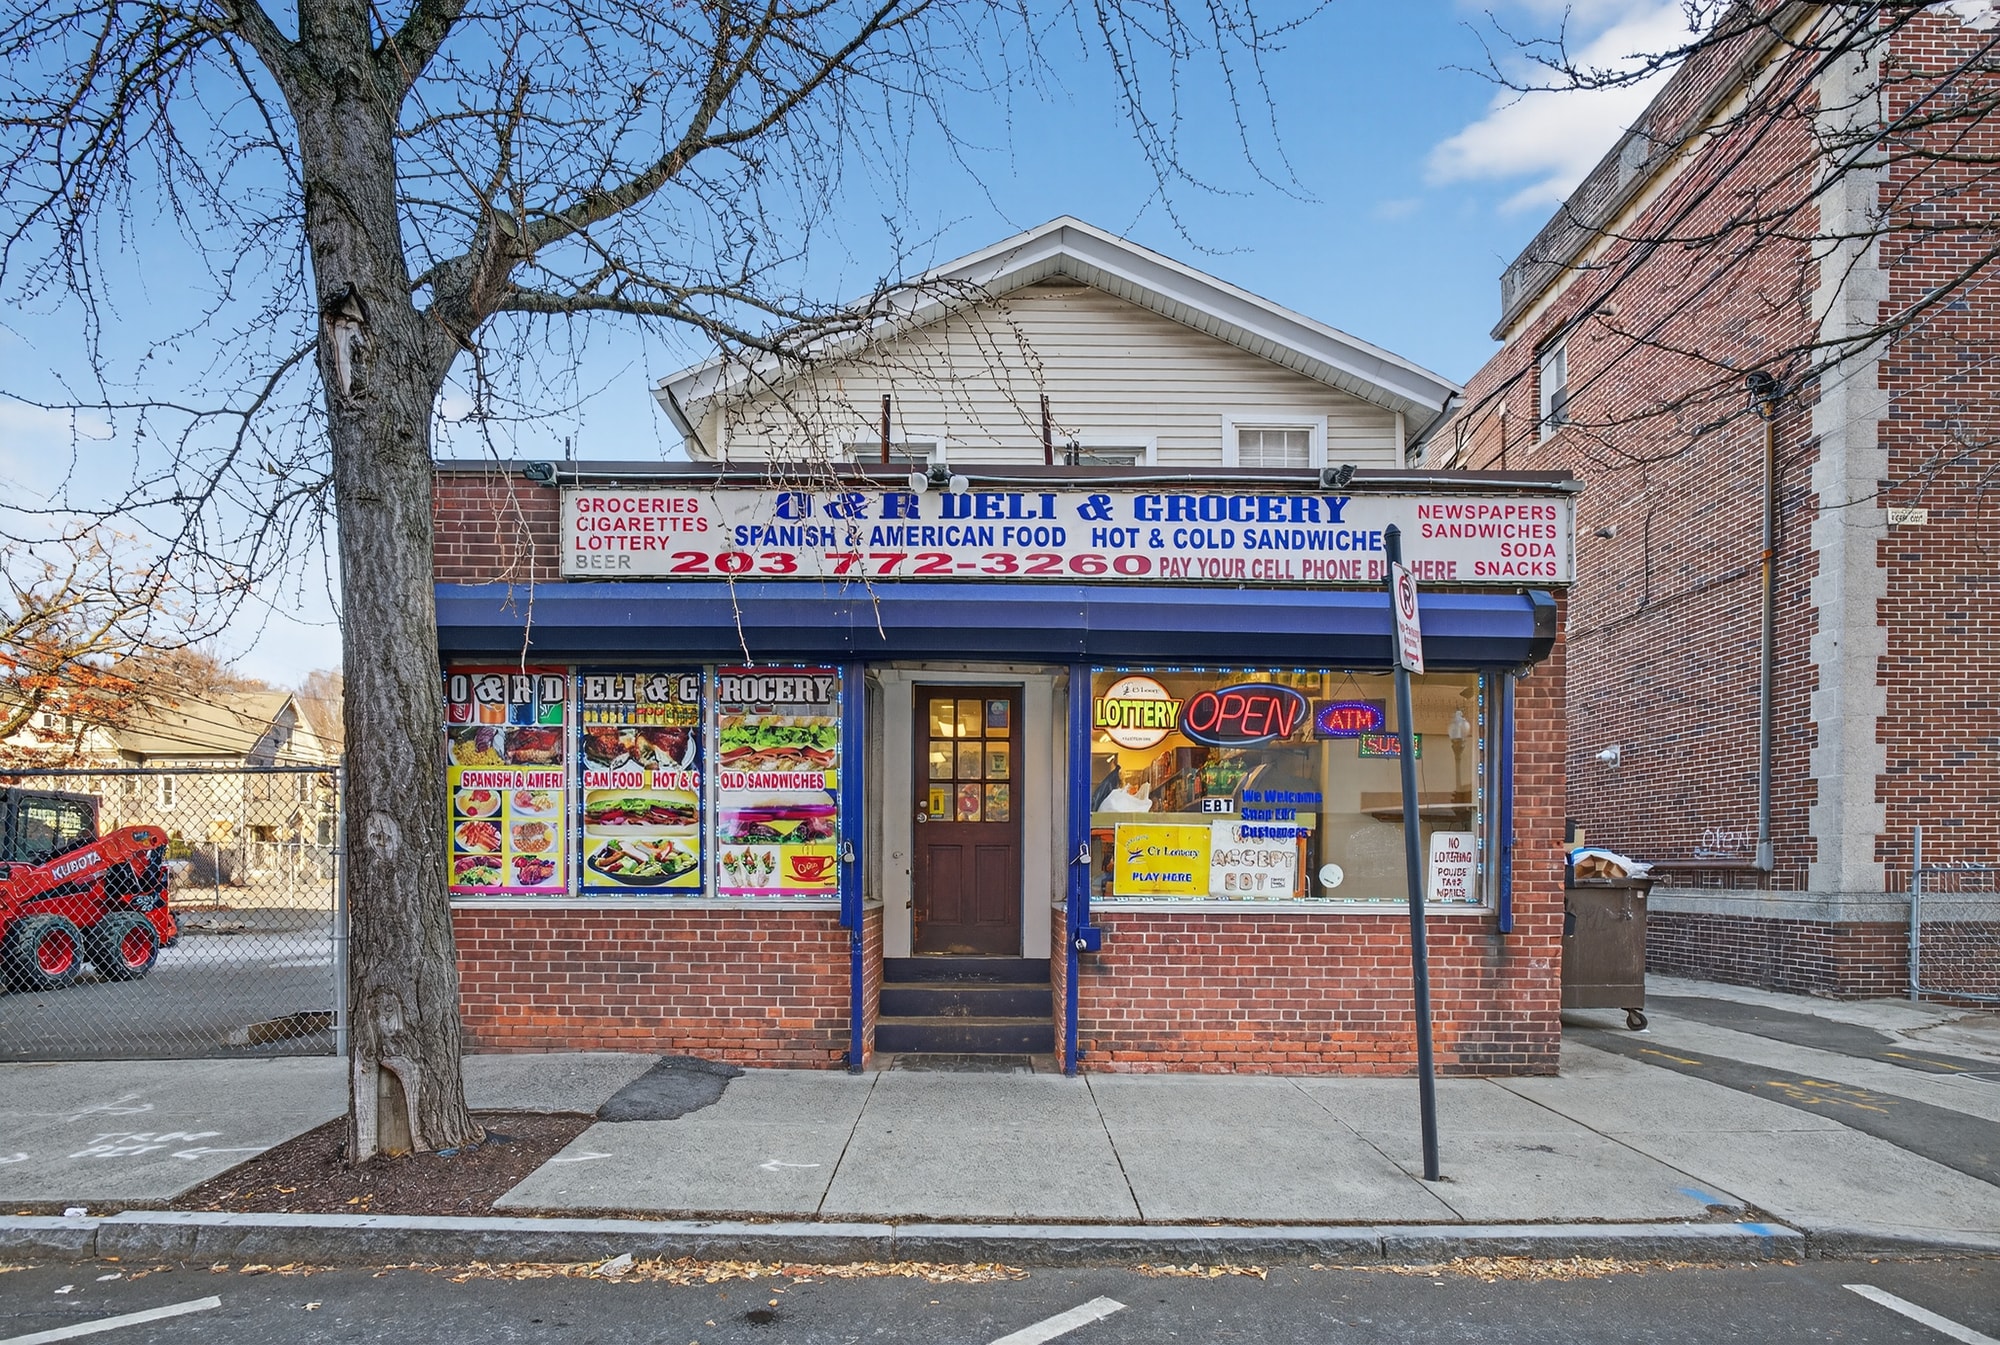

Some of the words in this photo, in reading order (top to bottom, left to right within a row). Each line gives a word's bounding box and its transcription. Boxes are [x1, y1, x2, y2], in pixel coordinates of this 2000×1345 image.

[576, 498, 699, 513] GROCERIES
[823, 492, 868, 520] &
[879, 493, 920, 519] R
[938, 493, 1057, 519] DELI
[1076, 494, 1113, 521] &
[1134, 495, 1351, 523] GROCERY
[1418, 505, 1557, 520] NEWSPAPERS
[576, 517, 708, 532] CIGARETTES
[1422, 523, 1557, 539] SANDWICHES
[576, 536, 669, 550] LOTTERY
[735, 525, 836, 547] SPANISH
[845, 526, 863, 547] &
[869, 526, 994, 547] AMERICAN
[1003, 526, 1066, 547] FOOD
[1092, 527, 1140, 548] HOT
[1149, 528, 1165, 548] &
[1173, 528, 1235, 549] COLD
[1243, 529, 1385, 551] SANDWICHE
[1501, 543, 1556, 557] SODA
[576, 554, 631, 569] BEER
[670, 551, 798, 573] 203
[824, 553, 1151, 575] 772-3260
[1159, 557, 1191, 577] PAY
[1197, 557, 1246, 578] YOUR
[1252, 558, 1294, 579] CELL
[1302, 559, 1361, 579] PHONE
[1368, 560, 1388, 579] BI
[1411, 560, 1456, 579] HERE
[1475, 561, 1557, 576] SNACKS
[450, 674, 468, 703] O
[475, 676, 504, 702] &
[511, 675, 532, 703] R
[543, 675, 564, 702] D
[585, 676, 636, 702] ELI
[645, 677, 669, 702] &
[680, 677, 698, 702] G
[720, 676, 833, 703] ROCERY
[1095, 699, 1180, 729] LOTTERY
[1188, 692, 1298, 736] OPEN
[1329, 709, 1372, 731] ATM
[462, 772, 511, 788] SPANISH
[515, 772, 524, 788] &
[527, 772, 563, 788] AMERI
[584, 772, 609, 788] CAN
[611, 772, 644, 788] FOOD
[653, 772, 676, 788] HOT
[680, 772, 689, 788] &
[720, 772, 744, 788] OLD
[749, 772, 824, 789] SANDWICHES
[1242, 789, 1262, 803] We
[1265, 790, 1322, 804] Welcome
[1203, 799, 1233, 812] EBT
[1241, 825, 1308, 839] Customers
[1448, 837, 1460, 849] NO
[52, 851, 103, 881] KUBOTA
[1212, 848, 1296, 868] ACCEPT
[1132, 872, 1160, 882] PLAY
[1162, 872, 1192, 883] HERE
